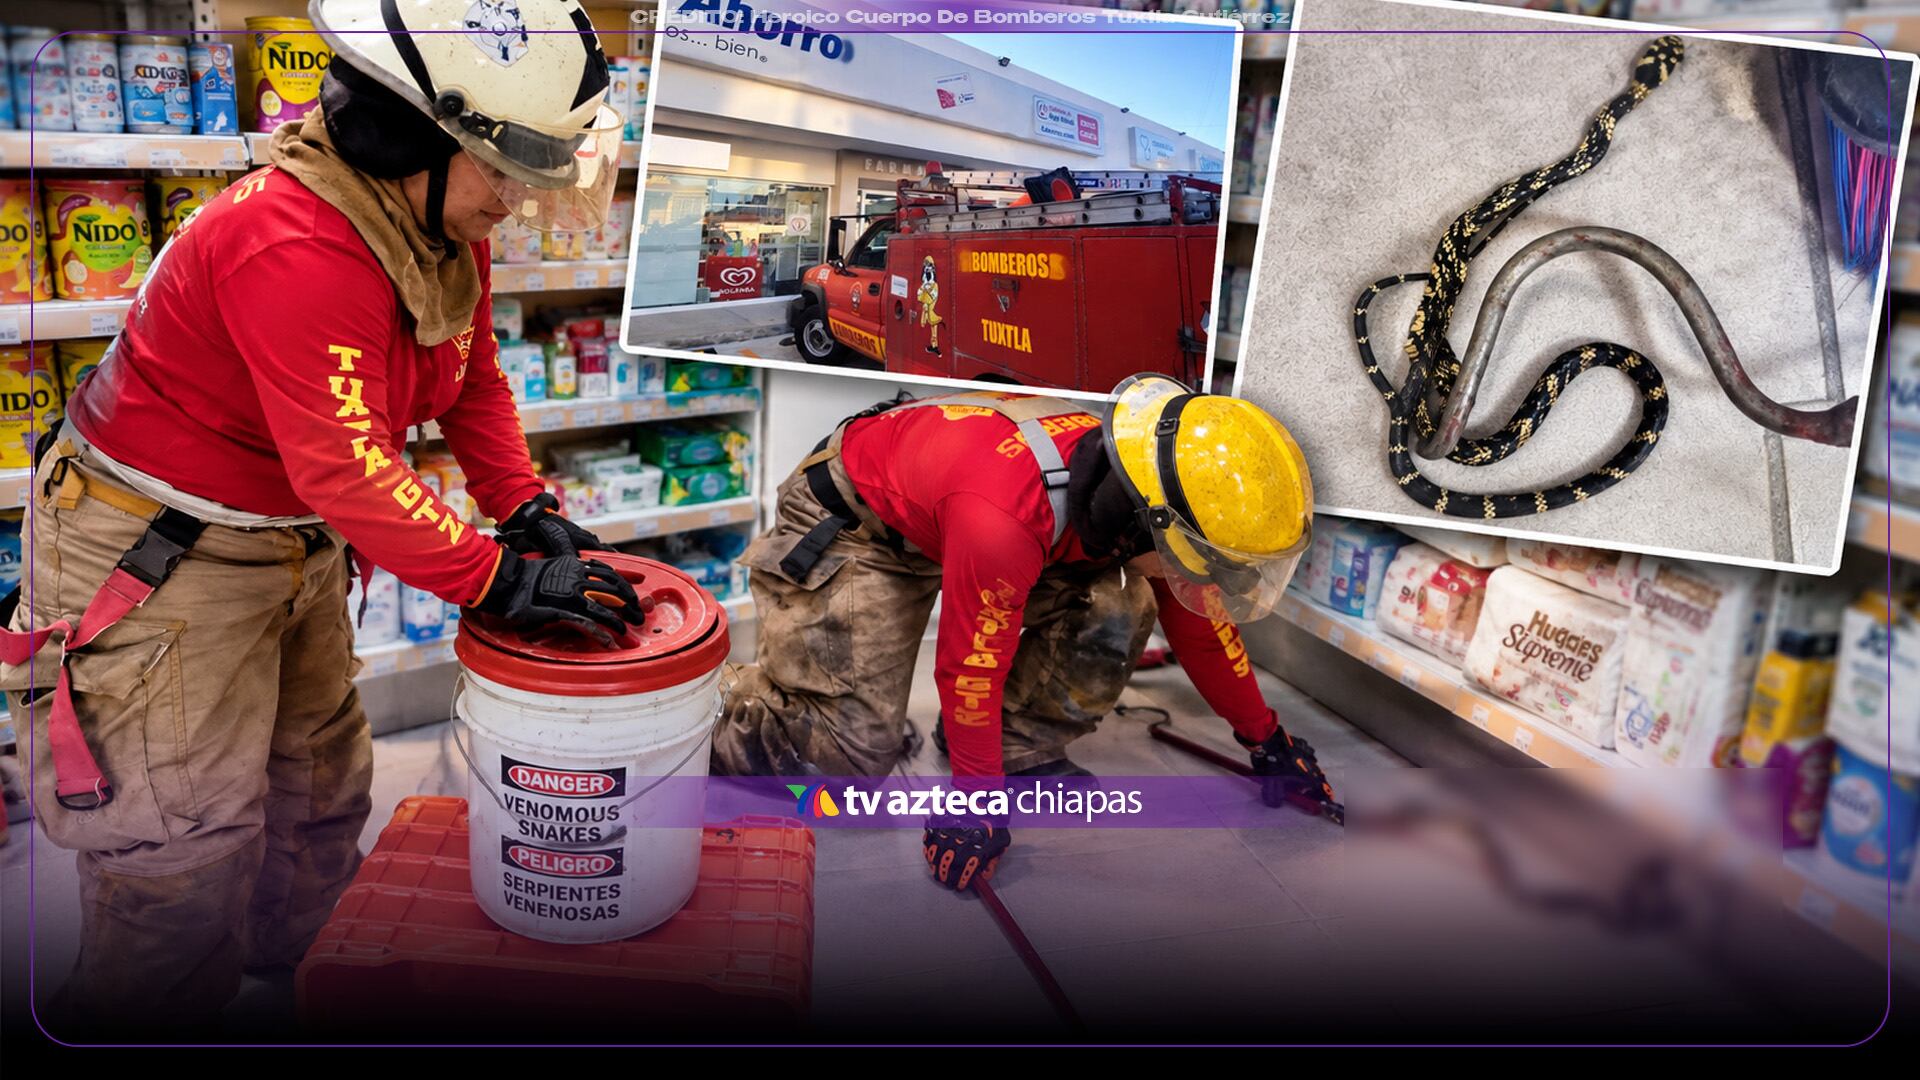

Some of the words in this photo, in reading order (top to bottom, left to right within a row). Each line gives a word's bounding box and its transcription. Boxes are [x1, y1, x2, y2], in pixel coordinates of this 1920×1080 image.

[73, 223, 136, 242] NIDO
[971, 251, 1049, 279] BOMBEROS
[981, 318, 1033, 353] TUXTLA
[517, 768, 605, 793] DANGER
[504, 793, 620, 823] VENOMOUS
[518, 819, 602, 843] SNAKES
[517, 848, 606, 873] PELIGRO
[503, 872, 621, 901] SERPIENTES
[504, 890, 620, 921] VENENOSAS
